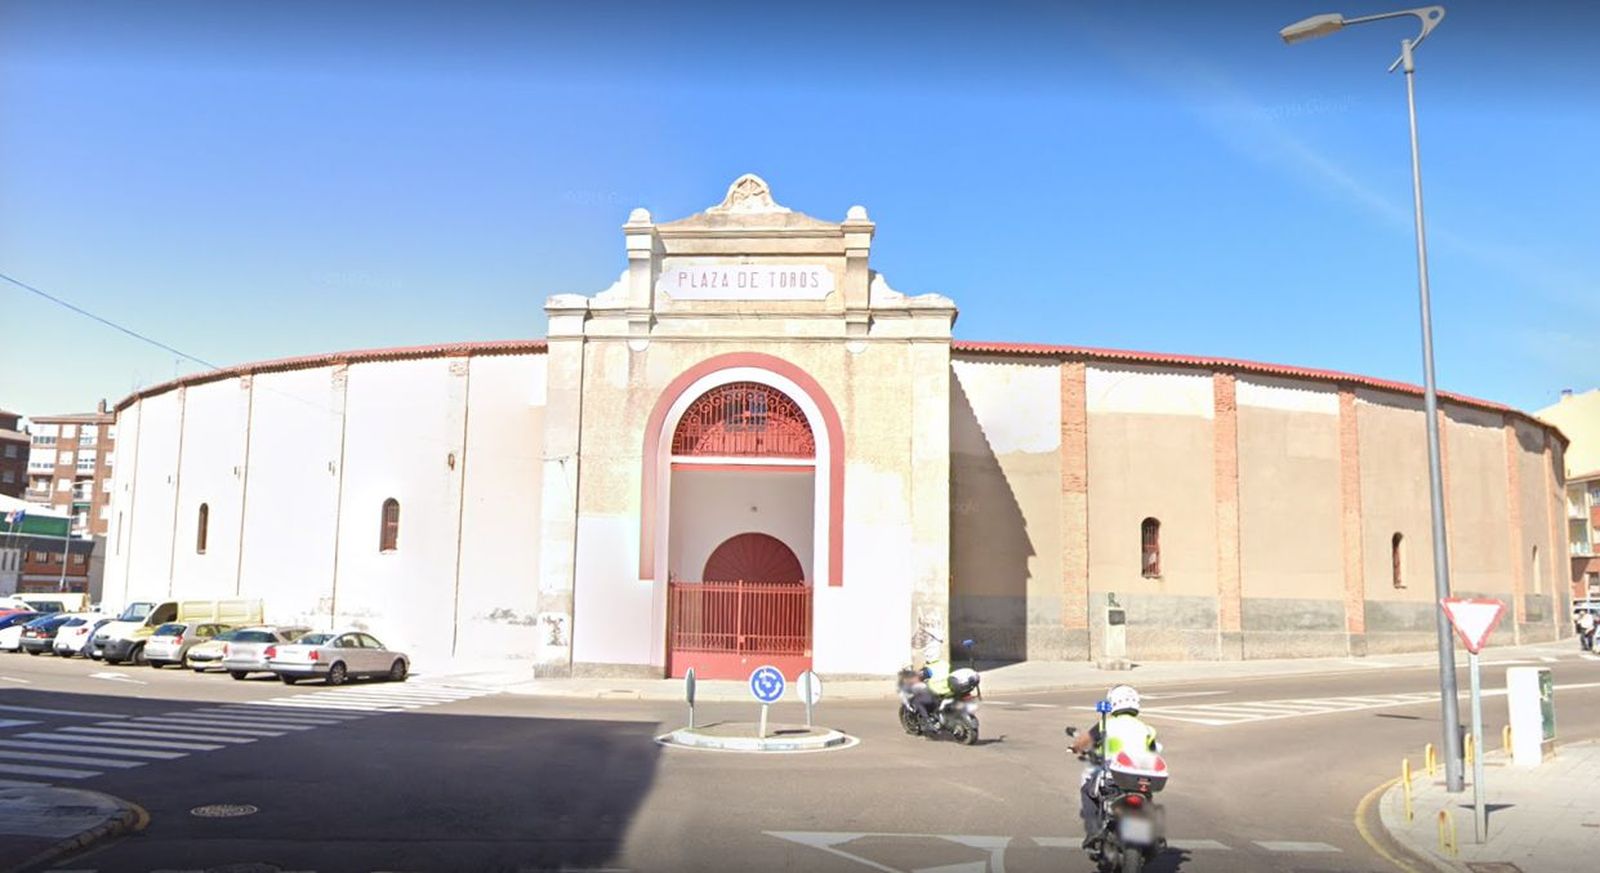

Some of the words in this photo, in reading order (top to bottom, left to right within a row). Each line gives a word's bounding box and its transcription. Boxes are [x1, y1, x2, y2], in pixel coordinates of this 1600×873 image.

[678, 271, 729, 288] PLAZA
[738, 271, 759, 288] DE
[768, 271, 820, 288] TOROS
